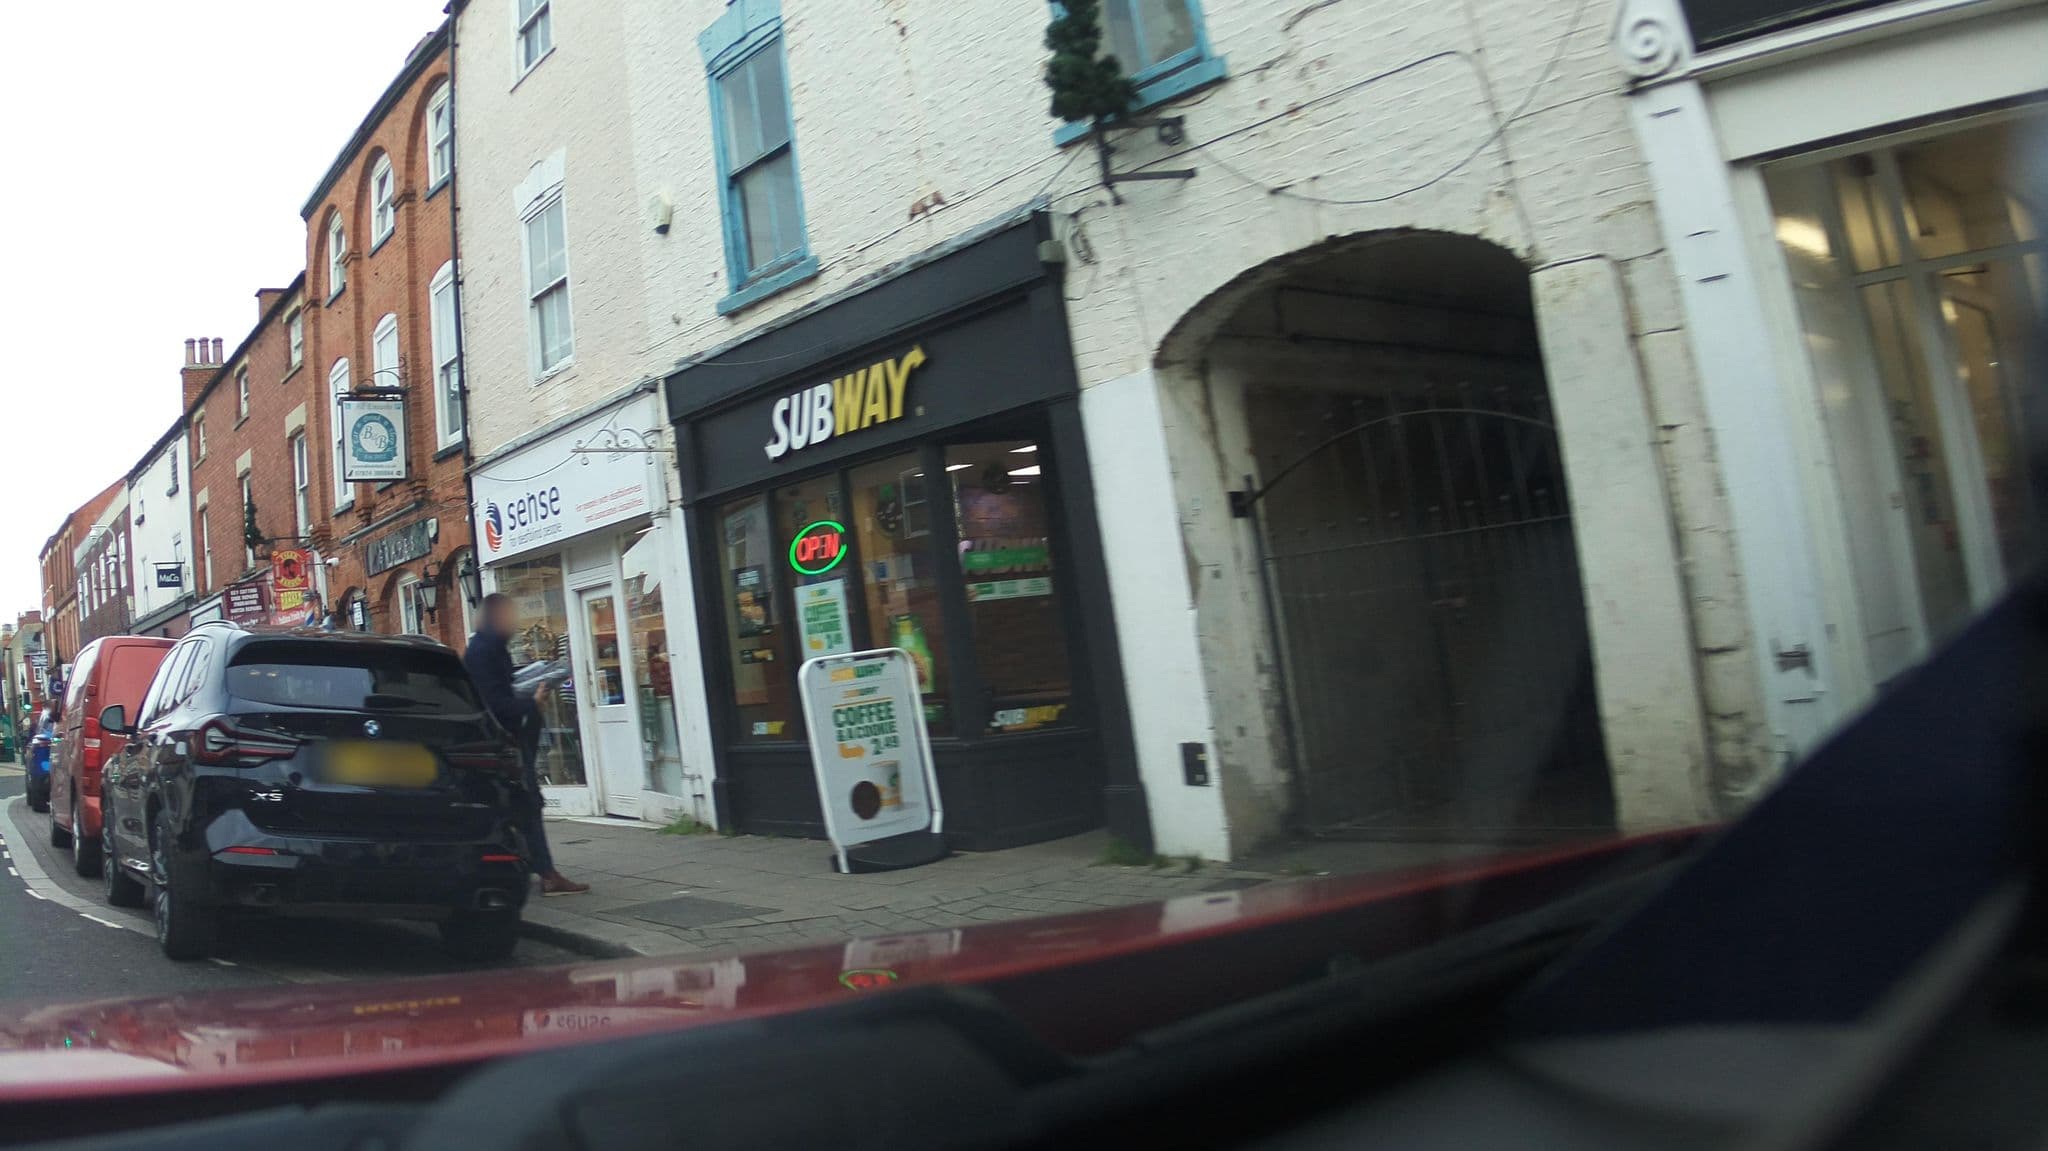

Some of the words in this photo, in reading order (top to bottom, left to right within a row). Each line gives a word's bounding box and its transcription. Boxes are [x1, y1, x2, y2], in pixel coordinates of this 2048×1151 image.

[764, 344, 927, 461] SUBWAY
[507, 486, 561, 531] sense
[796, 533, 839, 562] OPEN
[832, 701, 896, 728] COFFEE
